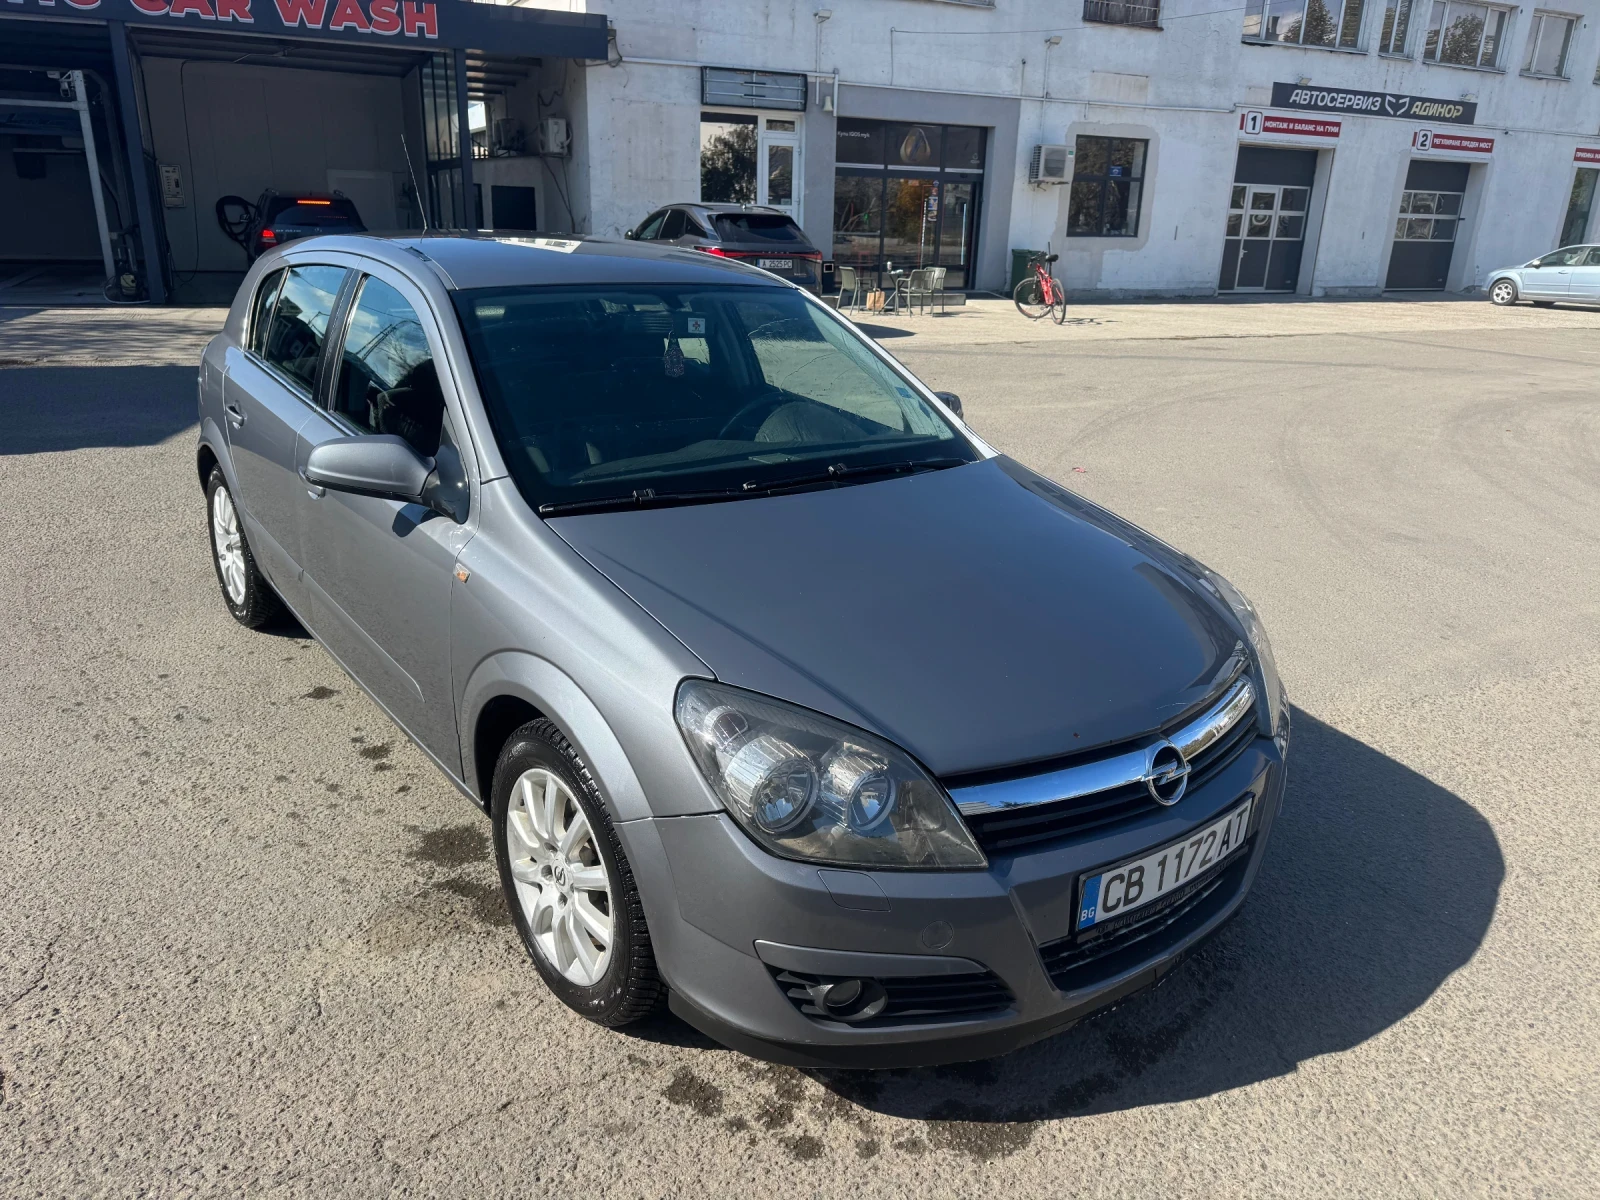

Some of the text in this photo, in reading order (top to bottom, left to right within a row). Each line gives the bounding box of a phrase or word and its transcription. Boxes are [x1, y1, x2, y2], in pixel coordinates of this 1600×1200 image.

[274, 0, 438, 38] WASH
[1289, 89, 1382, 111] АВТОСЕРВИЗ
[1251, 115, 1257, 130] 1
[1264, 121, 1288, 130] МОНТАЖ
[1294, 123, 1316, 131] БАЛАНС
[1325, 125, 1340, 133] ГУМИ
[1420, 133, 1428, 147] 2
[1102, 865, 1145, 913] CB
[1081, 906, 1096, 921] BG
